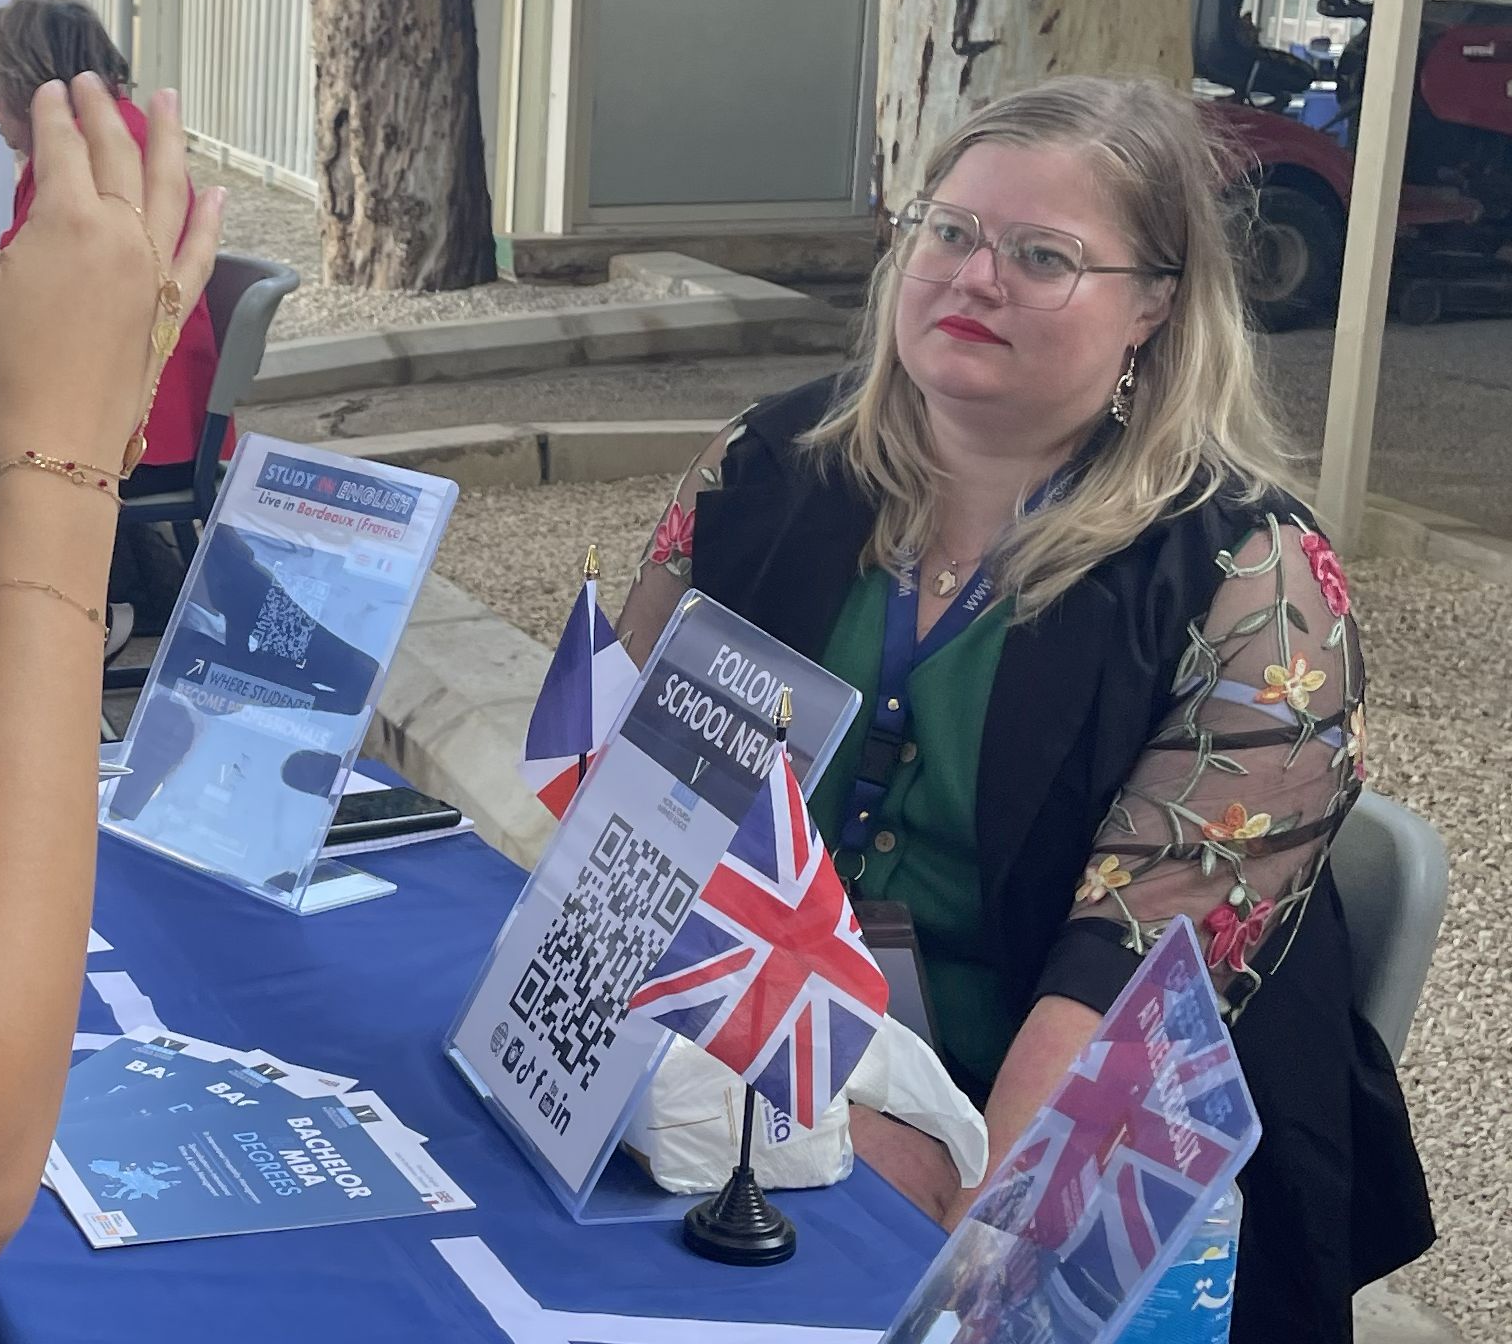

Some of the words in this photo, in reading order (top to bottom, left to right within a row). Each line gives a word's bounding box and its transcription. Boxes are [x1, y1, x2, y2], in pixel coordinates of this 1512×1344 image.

[258, 490, 281, 508] Live
[283, 497, 295, 511] in
[296, 501, 354, 528] Bordeaux
[265, 464, 316, 490] STUDY
[336, 480, 413, 514] ENGLISH
[210, 670, 250, 697] WHERE
[250, 685, 311, 717] STUDENTS
[707, 644, 785, 718] FOLLOW
[657, 673, 734, 748] SCHOOL
[726, 721, 793, 779] NEW
[125, 1059, 176, 1079] BA
[233, 1131, 302, 1196] DEGREES
[278, 1149, 326, 1187] MBA
[287, 1116, 372, 1199] BACHELOR
